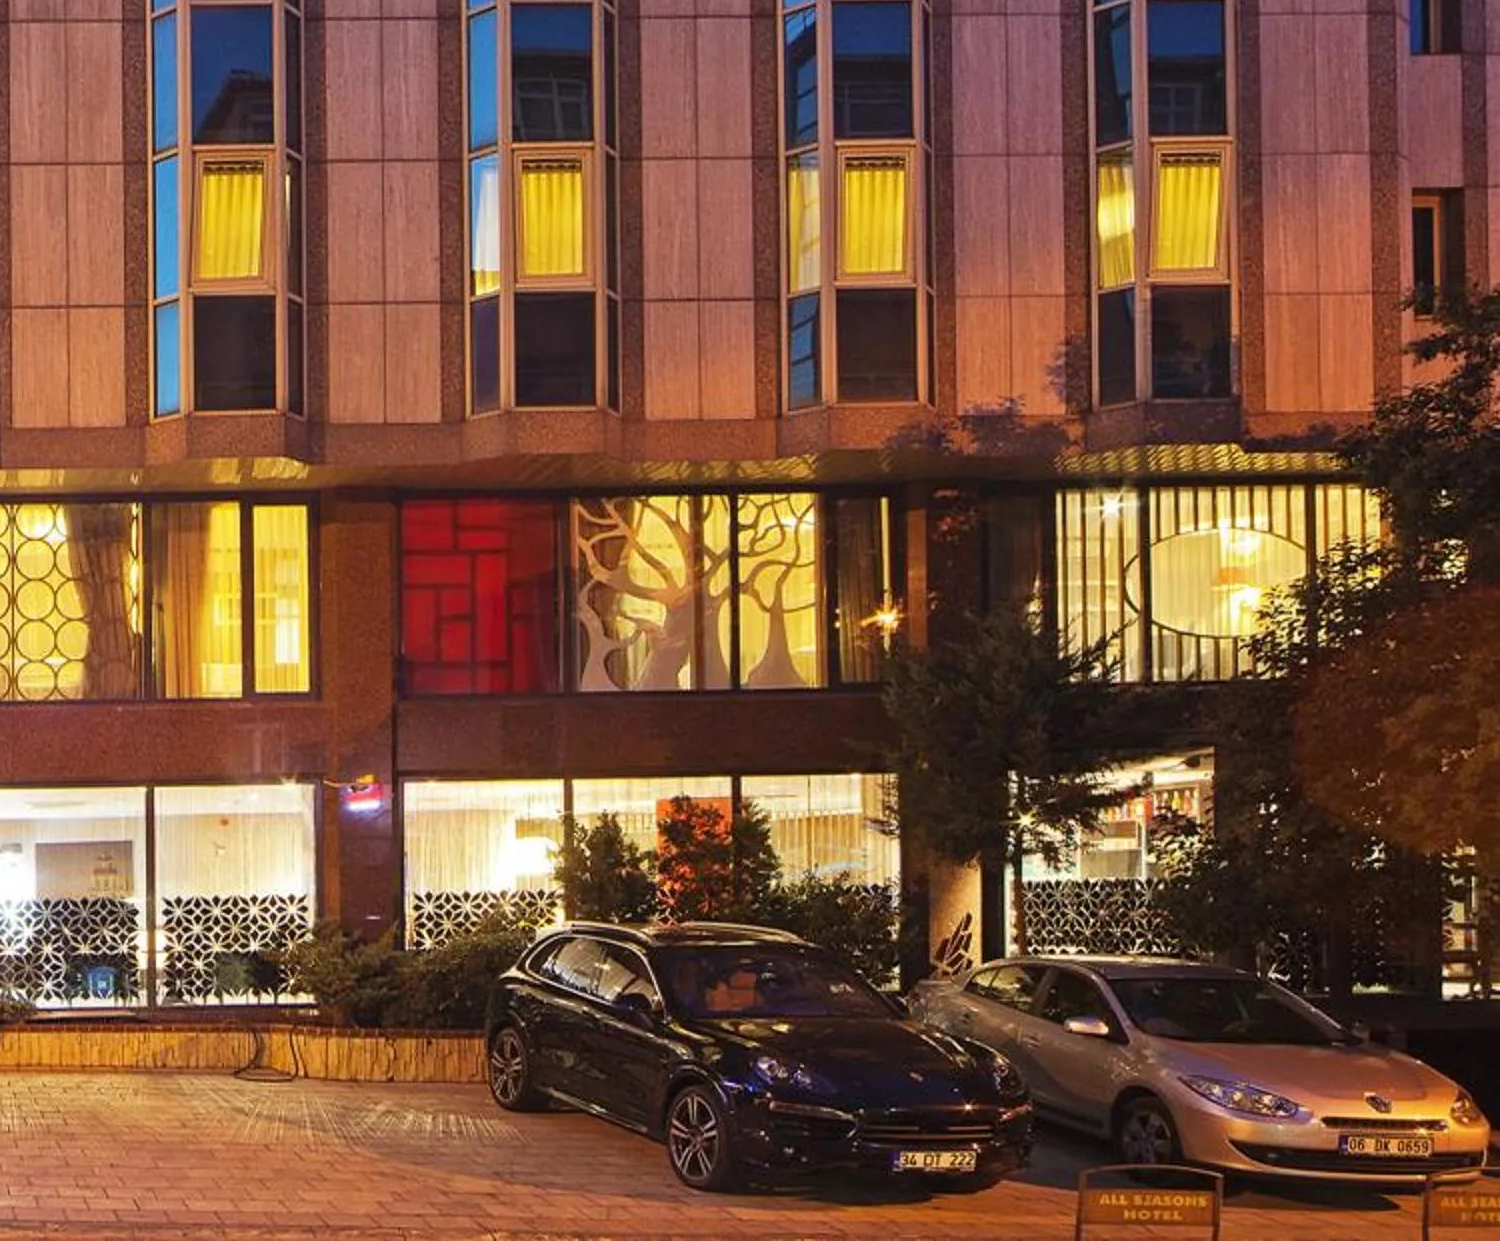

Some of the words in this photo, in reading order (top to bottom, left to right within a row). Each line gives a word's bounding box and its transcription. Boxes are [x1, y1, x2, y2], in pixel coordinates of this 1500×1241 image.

[1349, 1138, 1365, 1151] 06
[1398, 1140, 1429, 1154] 0659
[950, 1152, 973, 1166] 222
[1100, 1194, 1128, 1206] ALL
[1133, 1194, 1207, 1208] SEASONS
[1471, 1197, 1500, 1208] SEA
[1124, 1209, 1183, 1221] HOTEL
